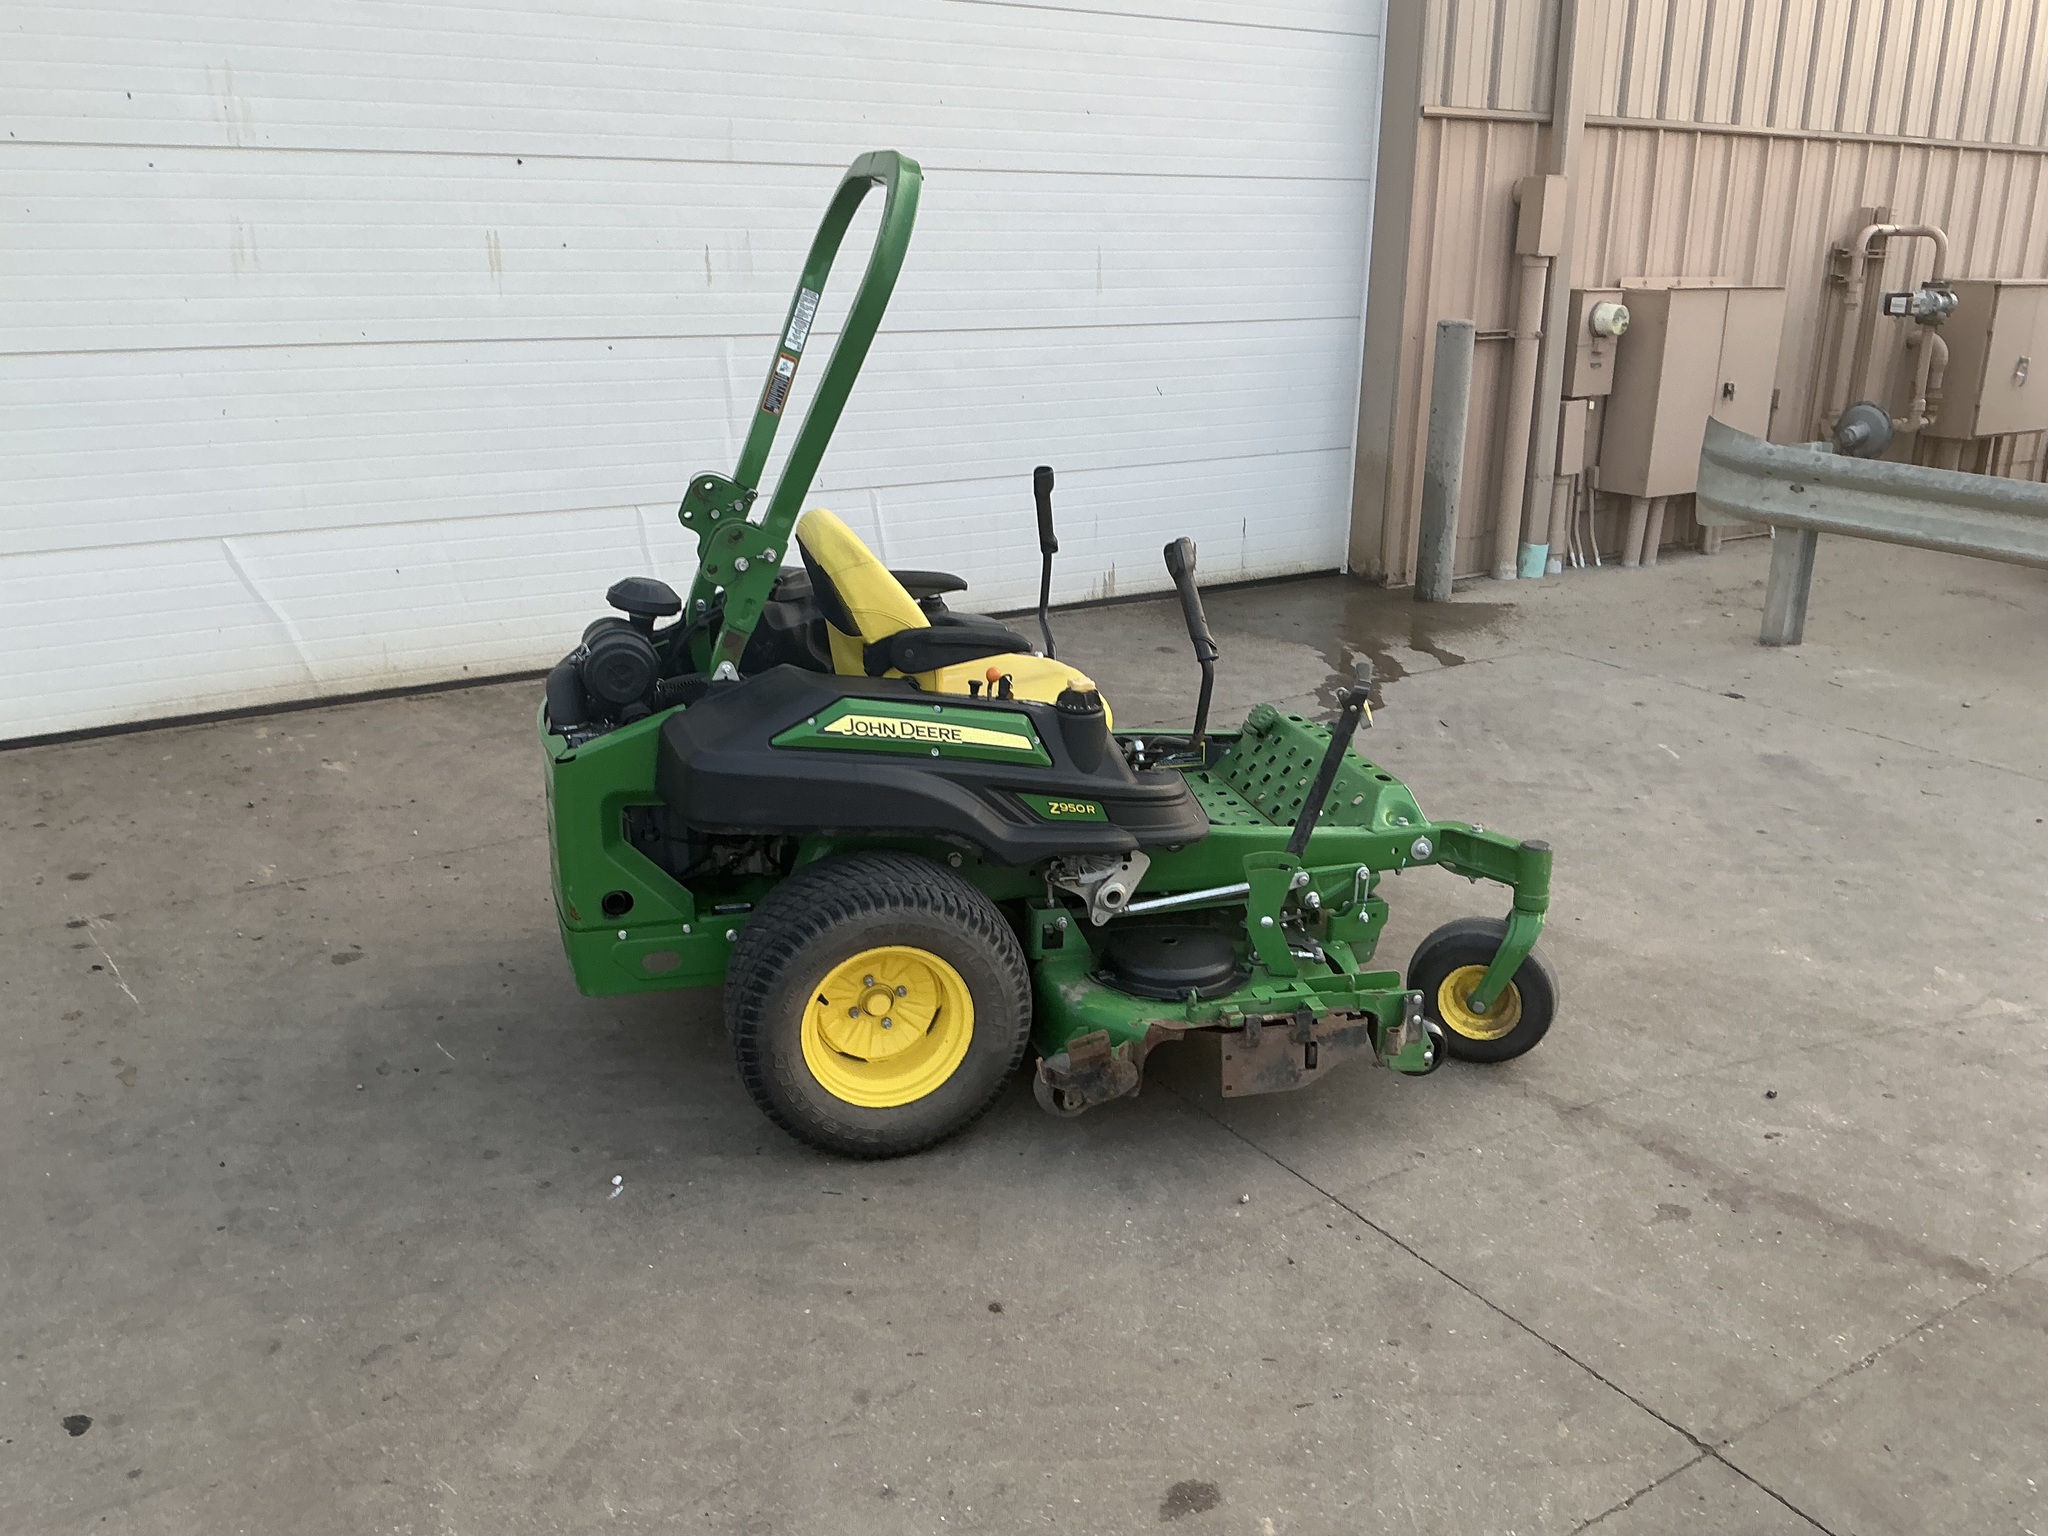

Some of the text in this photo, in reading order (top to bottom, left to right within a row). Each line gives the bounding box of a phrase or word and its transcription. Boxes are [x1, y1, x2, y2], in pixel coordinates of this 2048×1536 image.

[844, 718, 962, 741] JOHN DEERE
[1048, 802, 1096, 815] Z950R
